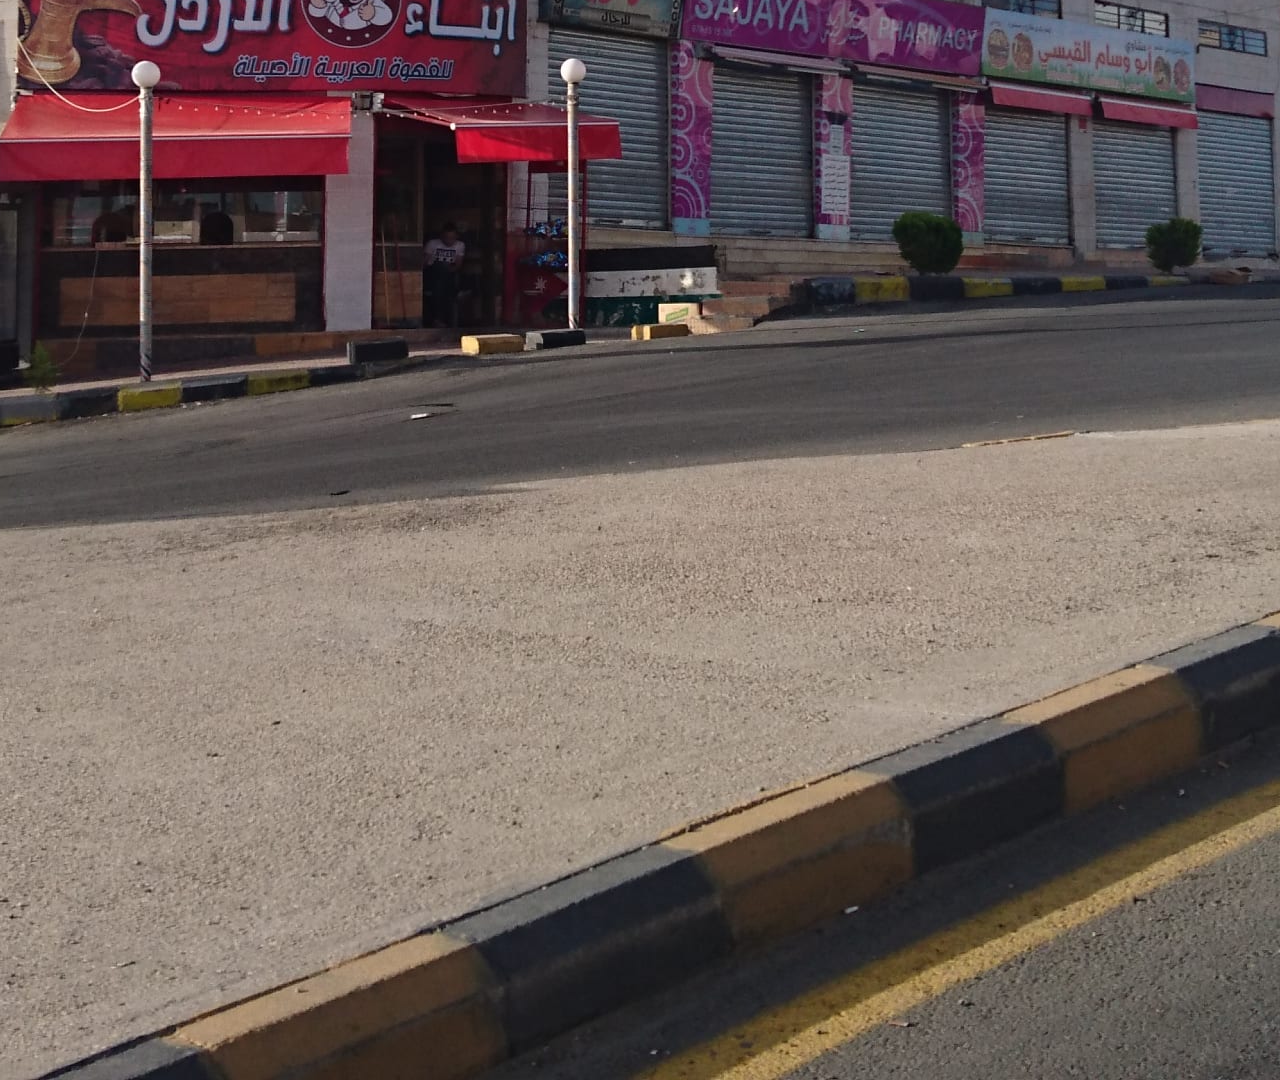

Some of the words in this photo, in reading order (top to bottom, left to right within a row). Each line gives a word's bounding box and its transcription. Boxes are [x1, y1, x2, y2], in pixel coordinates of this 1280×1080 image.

[878, 17, 978, 52] PHARMACY
[233, 53, 312, 80] الأصيلة
[314, 56, 387, 83] العربية
[388, 57, 454, 81] للقهوة
